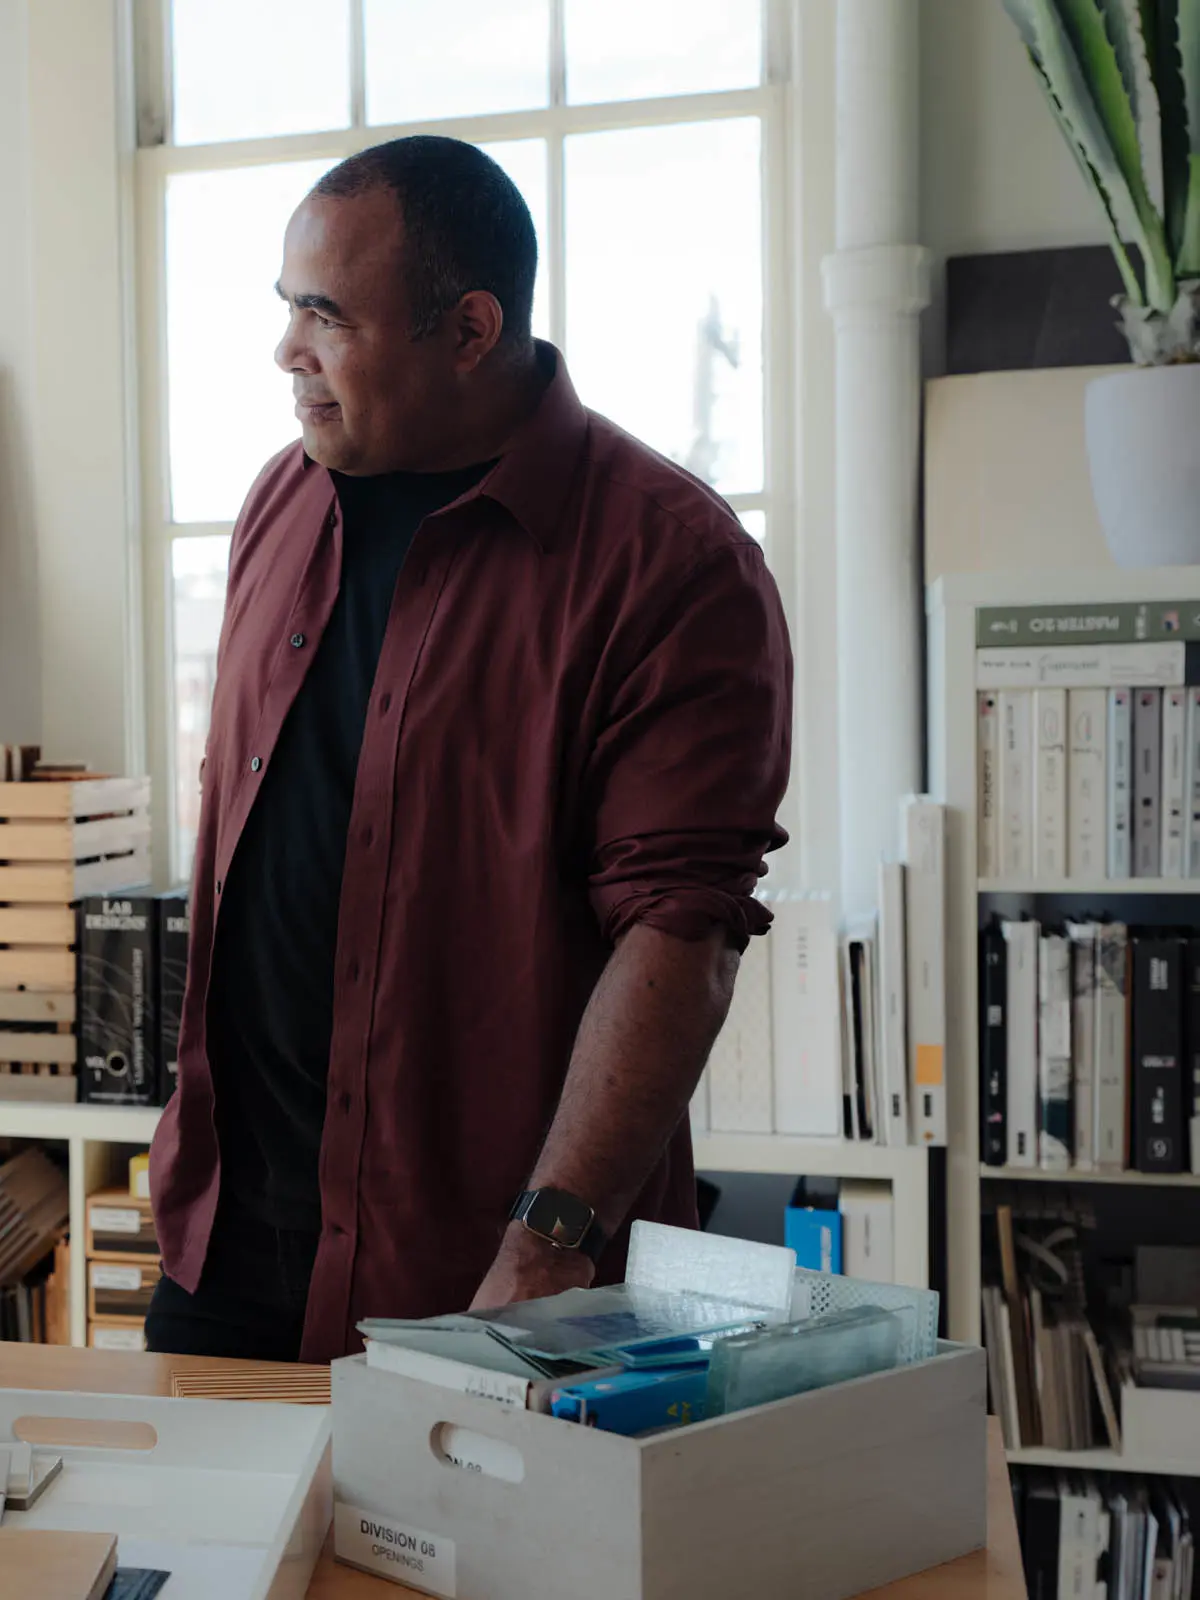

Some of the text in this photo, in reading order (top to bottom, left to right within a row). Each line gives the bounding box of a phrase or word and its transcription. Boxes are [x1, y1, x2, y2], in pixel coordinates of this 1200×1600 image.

[102, 900, 133, 915] LAB
[85, 914, 147, 931] DESIGNS
[360, 1519, 417, 1551] DIVISION
[371, 1544, 425, 1572] OPENINGS
